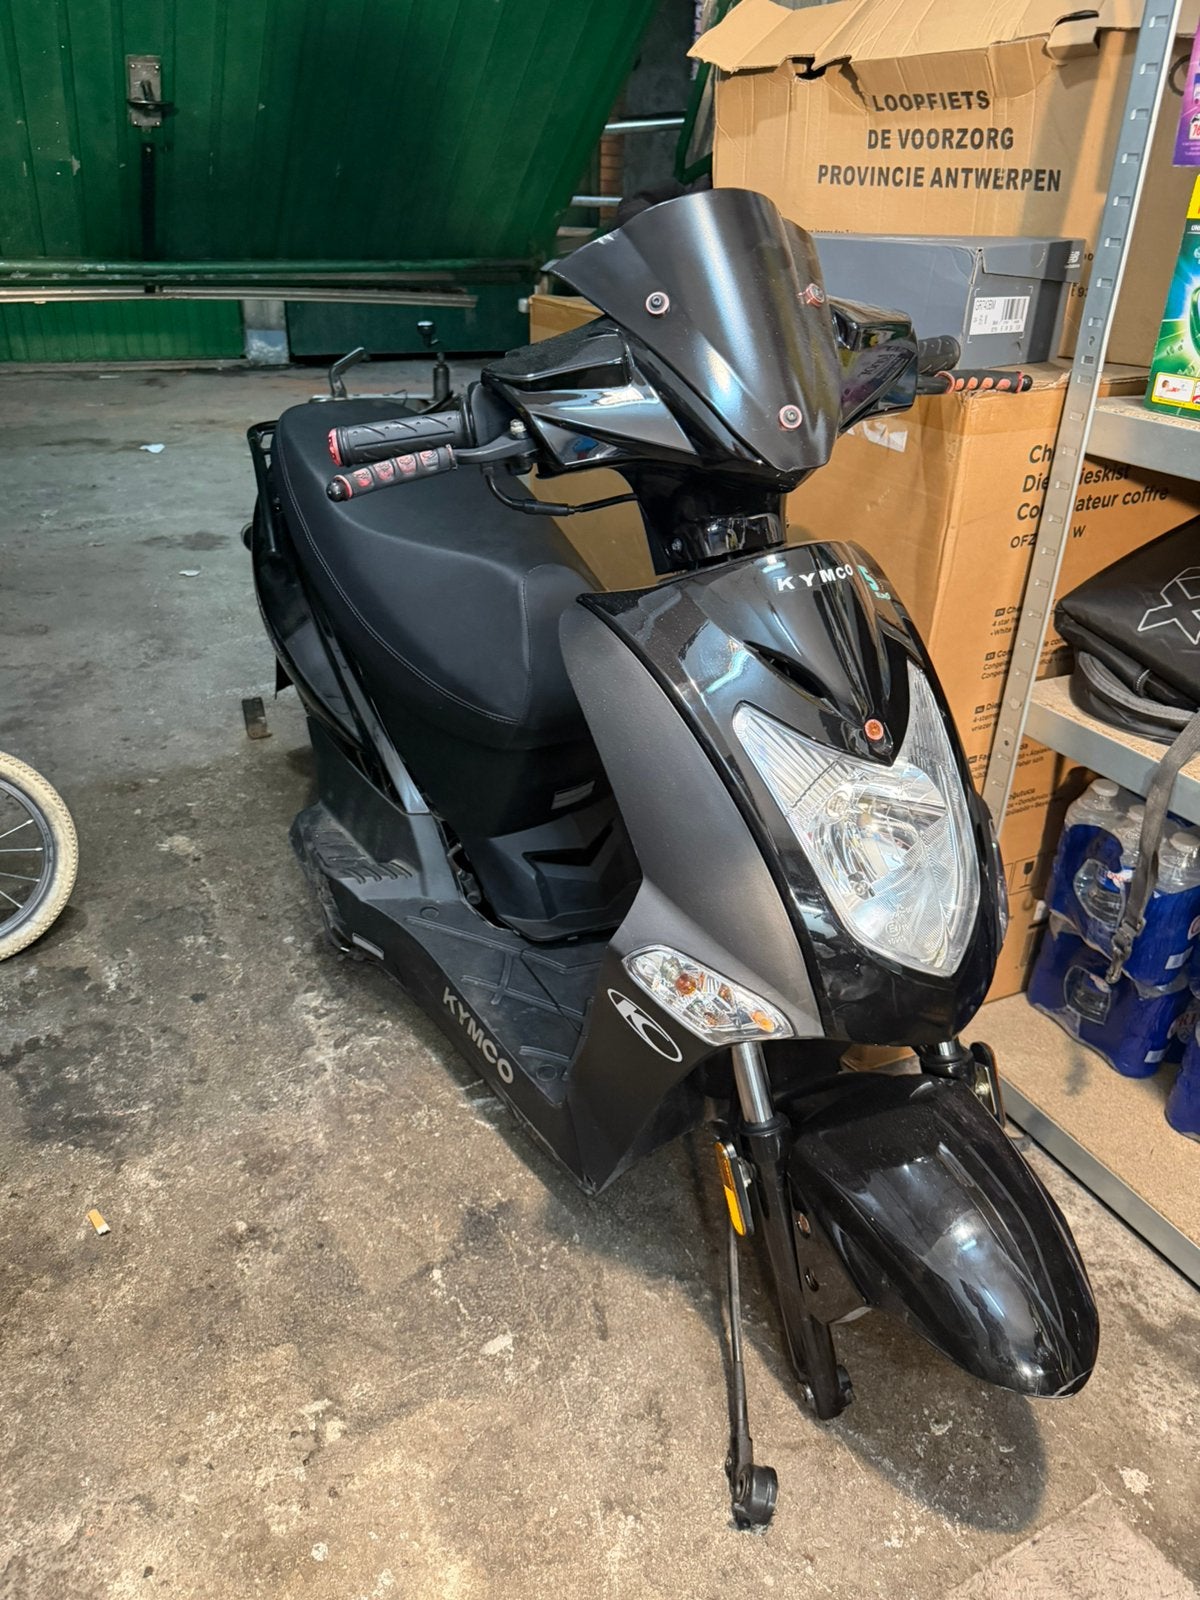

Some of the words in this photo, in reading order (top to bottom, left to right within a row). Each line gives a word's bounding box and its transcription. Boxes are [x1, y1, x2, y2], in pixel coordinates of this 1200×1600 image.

[873, 90, 990, 112] LOOPFIETS
[867, 128, 891, 149] DE
[897, 127, 1014, 150] VOORZORG
[817, 164, 925, 187] PROVINCIE
[929, 167, 1061, 191] ANTWERPEN
[1122, 486, 1169, 506] coffre
[776, 563, 854, 592] KYMCO
[443, 987, 514, 1084] KYMCO
